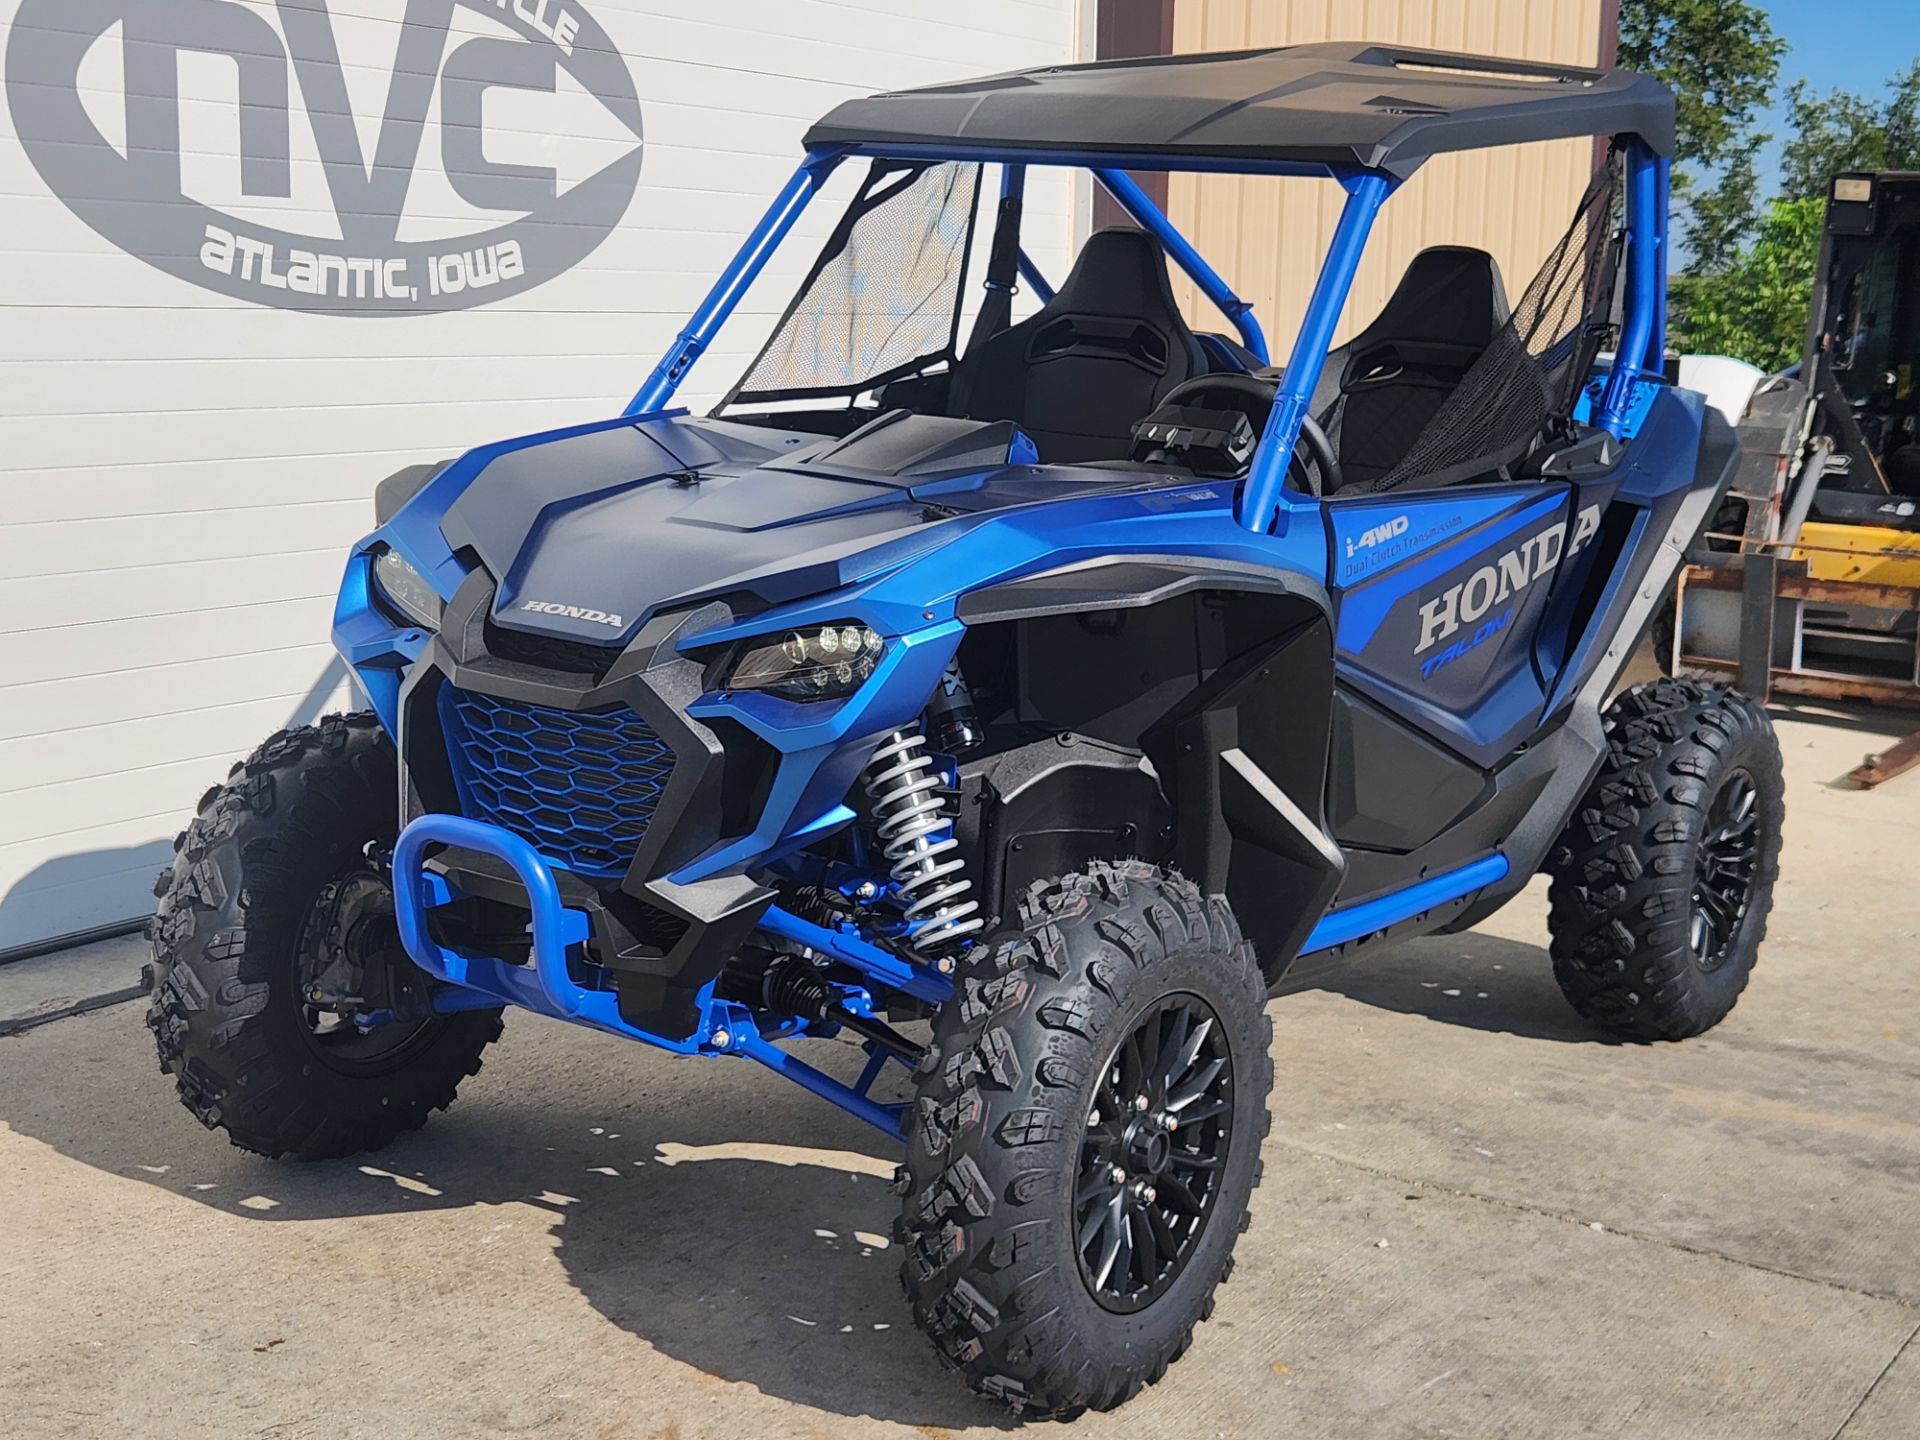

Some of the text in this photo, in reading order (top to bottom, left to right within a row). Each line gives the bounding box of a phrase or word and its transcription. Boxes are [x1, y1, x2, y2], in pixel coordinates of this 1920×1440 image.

[1345, 516, 1462, 578] Dual Clutch Transmission
[1346, 515, 1409, 558] i-4WD
[1413, 504, 1600, 655] HONDA
[520, 600, 623, 628] HONDA
[1420, 608, 1513, 680] TALON
